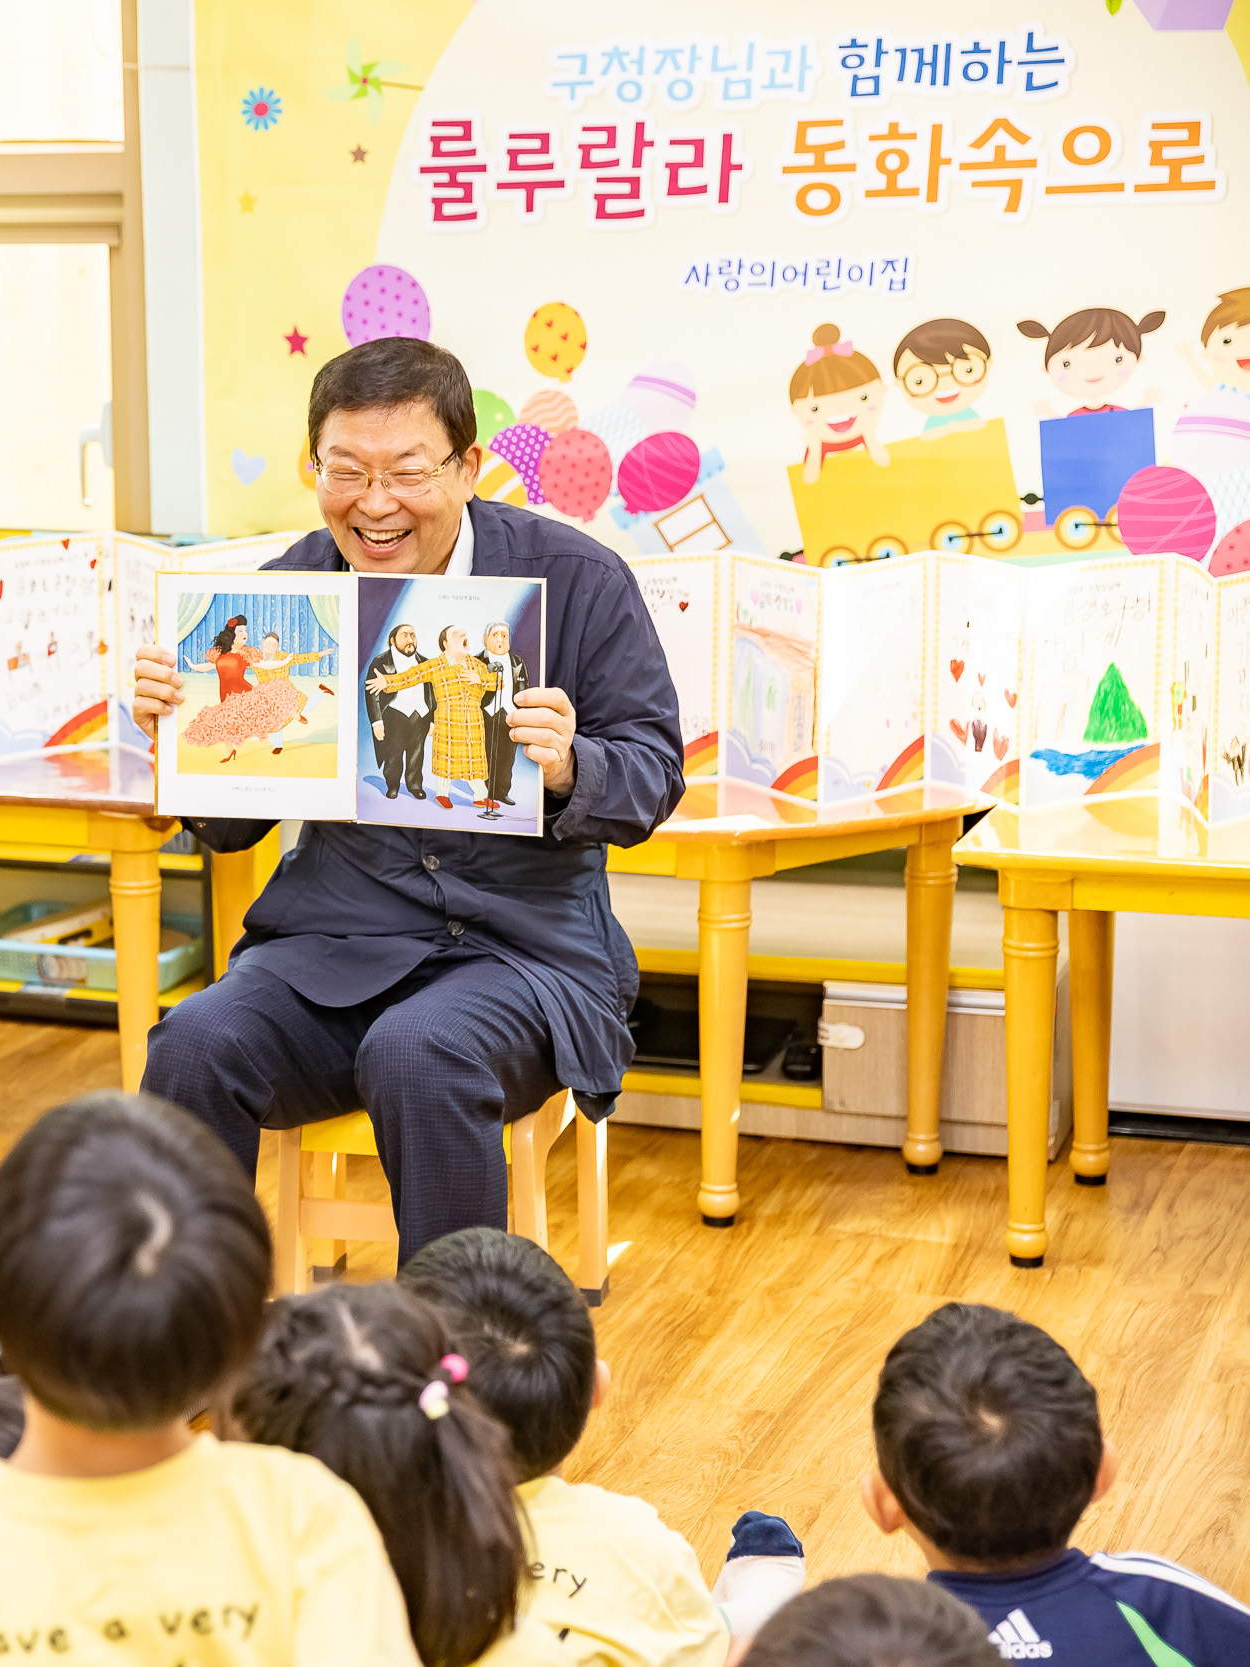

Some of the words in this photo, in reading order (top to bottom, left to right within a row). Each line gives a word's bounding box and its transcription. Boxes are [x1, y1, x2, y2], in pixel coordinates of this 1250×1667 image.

[551, 43, 813, 103] 구청장님과
[839, 31, 1066, 98] 함께하는
[419, 118, 743, 223] 룰루랄라
[782, 117, 1218, 217] 동화속으로
[683, 256, 912, 293] 사랑의어린이집
[531, 1561, 588, 1598] ery
[103, 1618, 127, 1641] a
[158, 1604, 259, 1640] very
[1000, 1640, 1053, 1659] idas
